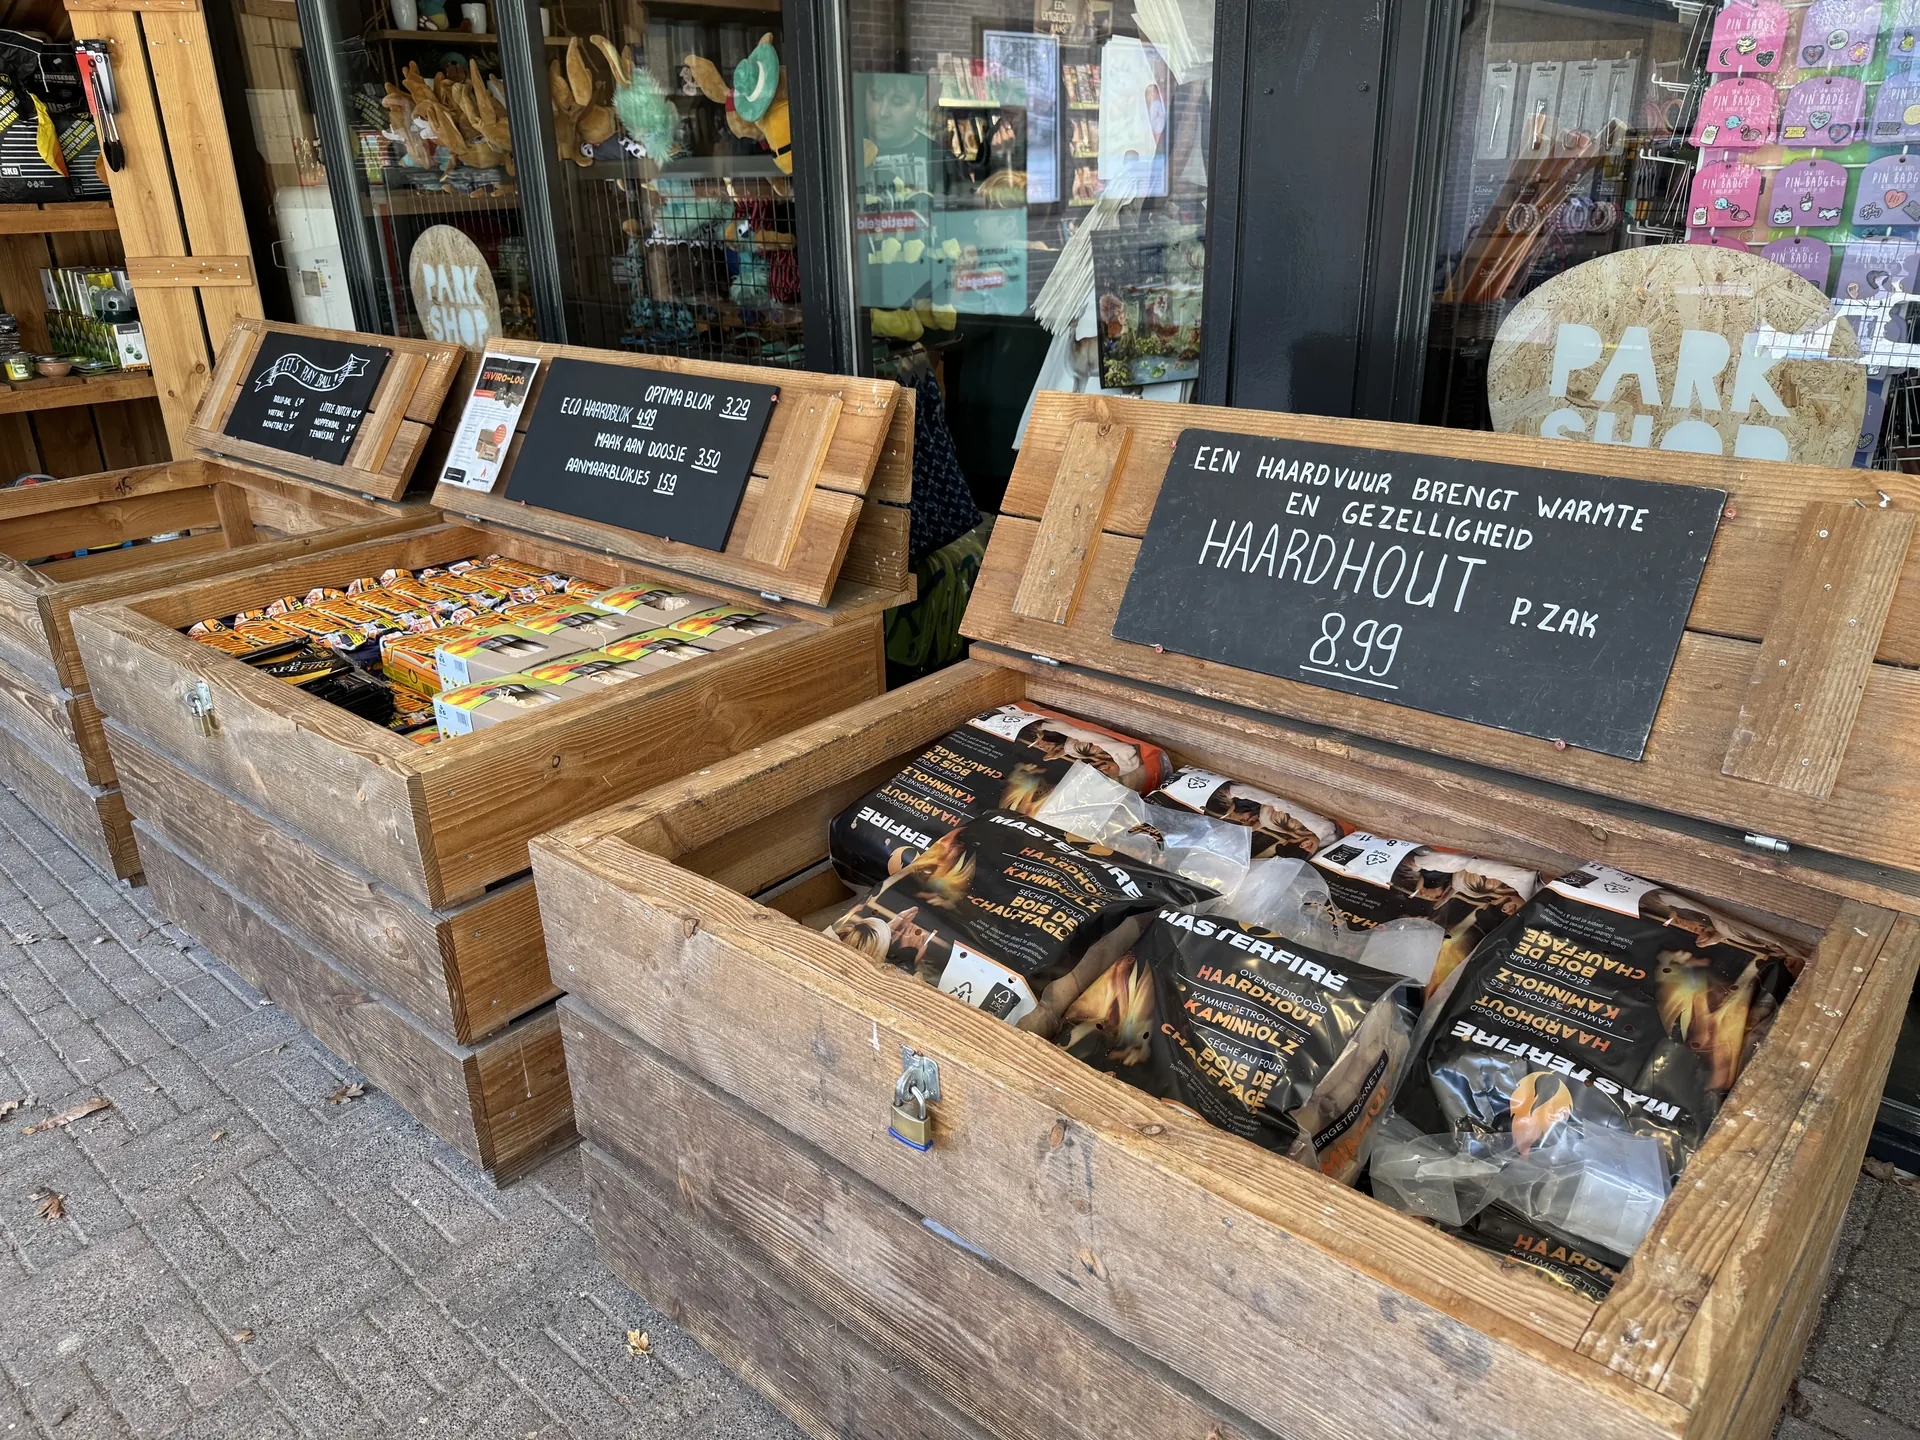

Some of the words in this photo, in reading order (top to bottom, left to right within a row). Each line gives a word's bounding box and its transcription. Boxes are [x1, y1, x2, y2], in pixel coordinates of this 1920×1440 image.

[1726, 18, 1745, 30] PIN
[1746, 18, 1776, 31] BADGE
[1713, 95, 1728, 107] PIN
[1732, 94, 1761, 107] BADGE
[1798, 94, 1815, 105] PIN
[1819, 93, 1850, 105] BADGE
[1890, 88, 1908, 99] PIN
[1, 166, 19, 176] 3KG
[1702, 178, 1716, 189] PIN
[1721, 176, 1749, 189] BADGE
[1785, 176, 1801, 188] PIN
[1805, 175, 1834, 188] BADGE
[1872, 172, 1888, 184] PIN
[1771, 252, 1786, 263] PIN
[1790, 251, 1819, 264] BADGE
[1855, 252, 1871, 264] PIN
[1876, 251, 1907, 264] BADGE
[422, 263, 484, 305] PARK
[429, 305, 489, 348] SHOP
[280, 357, 301, 374] LET'S
[300, 366, 316, 386] PLAY
[482, 371, 526, 386] ENVIRO-LOG
[1550, 323, 1791, 417] PARK
[335, 405, 352, 417] DUTCH
[560, 397, 582, 416] ECO
[582, 399, 634, 424] HAARDBLOK
[644, 385, 684, 407] OPTIMA
[684, 391, 715, 411] BLOK
[722, 396, 751, 417] 3.29
[594, 432, 624, 451] MAAK
[623, 437, 645, 455] AAN
[647, 441, 688, 463] DOOSJE
[693, 447, 721, 469] 3.50
[564, 457, 651, 486] AANMAAKBLOKJES
[1193, 445, 1241, 474] EEN
[1256, 456, 1393, 496] HAARDVUUR
[1411, 478, 1520, 513] BRENGT
[1537, 496, 1650, 532] WARMTE
[1284, 491, 1318, 519] EN
[1342, 501, 1534, 551] GEZELLIGHEID
[1198, 517, 1488, 613] HAARDHOUT
[1308, 612, 1403, 677] 8.99
[921, 750, 943, 764] DE
[933, 744, 1005, 780] CHAUFFAGE
[945, 758, 973, 777] BOIS
[900, 765, 976, 804] KAMINHOLZ
[875, 791, 930, 822] OVENGEDROOGD
[880, 784, 962, 828] HAARDHOUT
[856, 805, 933, 852] ERFIRE
[1009, 895, 1054, 916] BOIS
[1052, 911, 1079, 932] DE
[1017, 887, 1047, 903] SÉCHÉ
[1045, 897, 1061, 908] AU
[1060, 904, 1086, 924] FOUR
[1157, 909, 1349, 992] MASTERFIRE
[1508, 952, 1539, 968] FOUR
[1513, 941, 1546, 960] DE
[1521, 927, 1647, 981] CHAUFFAGE
[1538, 962, 1553, 972] AU
[1546, 953, 1598, 979] BOIS
[1239, 968, 1328, 1015] OVENGEDROOGD
[1494, 966, 1622, 1020] KAMINHOLZ
[1555, 967, 1593, 987] SÉCHÉ
[1196, 964, 1323, 1029] HAARDHOUT
[1183, 998, 1302, 1057] KAMINHOLZ
[1469, 1004, 1560, 1045] OVENGEDROOGD
[1474, 994, 1611, 1054] HAARDHOUT
[1160, 1022, 1270, 1110] CHAUFFAGE
[1199, 1047, 1251, 1081] BOIS
[1251, 1070, 1278, 1092] DE
[1207, 1036, 1242, 1058] SÉCHÉ
[1242, 1051, 1259, 1065] AU
[1258, 1058, 1284, 1074] FOUR
[1450, 1019, 1682, 1122] MASTERFIRE
